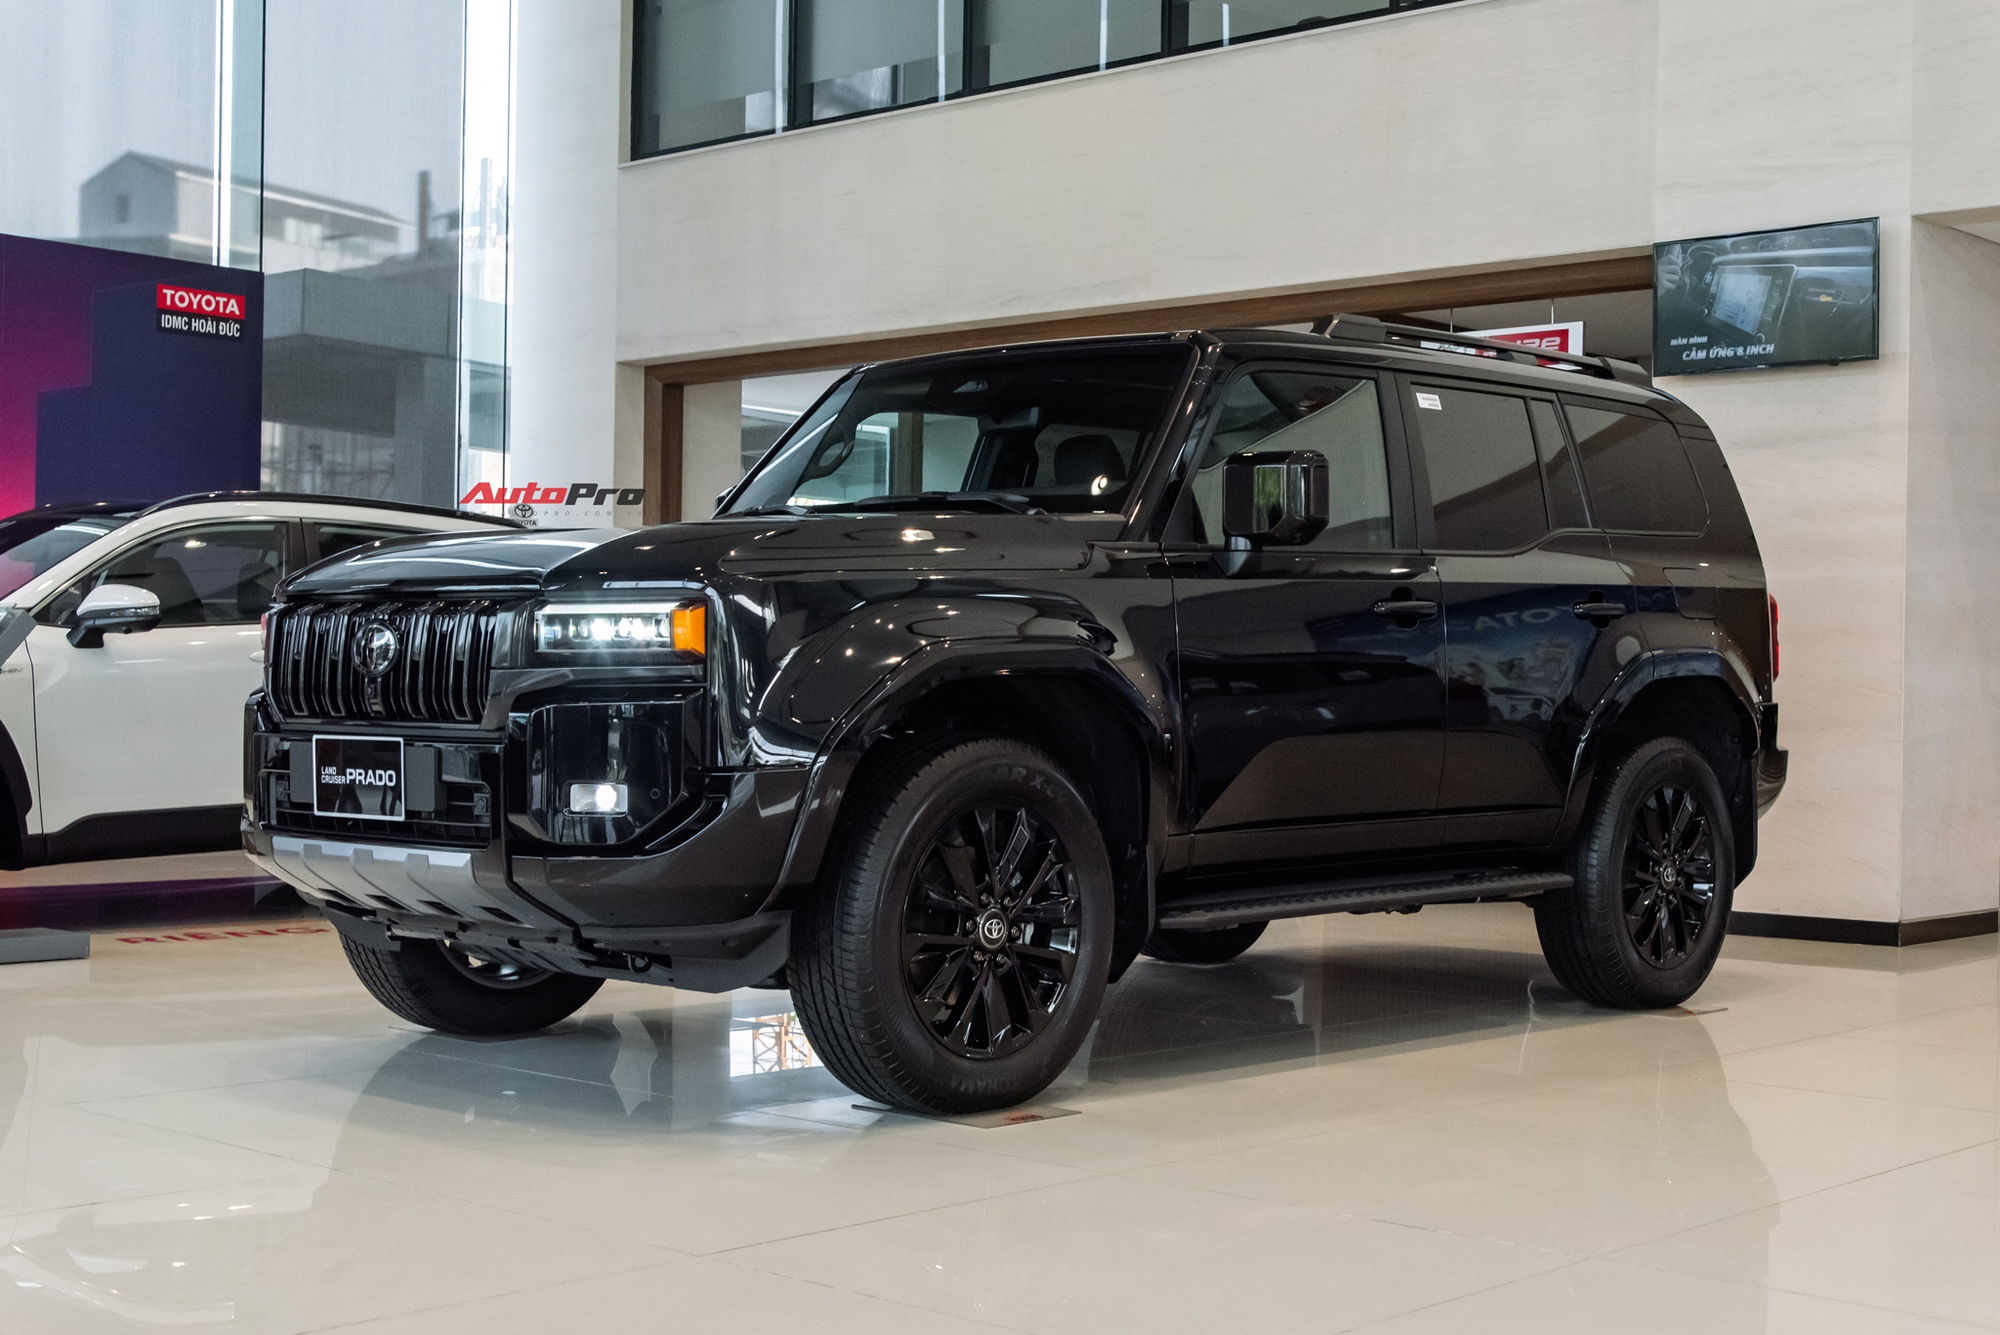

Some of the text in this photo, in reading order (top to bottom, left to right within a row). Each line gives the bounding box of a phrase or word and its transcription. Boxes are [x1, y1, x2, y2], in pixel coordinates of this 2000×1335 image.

[163, 288, 240, 315] TOYOTA
[161, 314, 240, 337] IDMC HOÀI ĐỨC
[1746, 343, 1775, 356] INCH
[515, 518, 537, 528] OYOTA
[321, 766, 337, 775] LAND
[321, 775, 346, 785] CRUISER
[346, 768, 396, 787] PRADO
